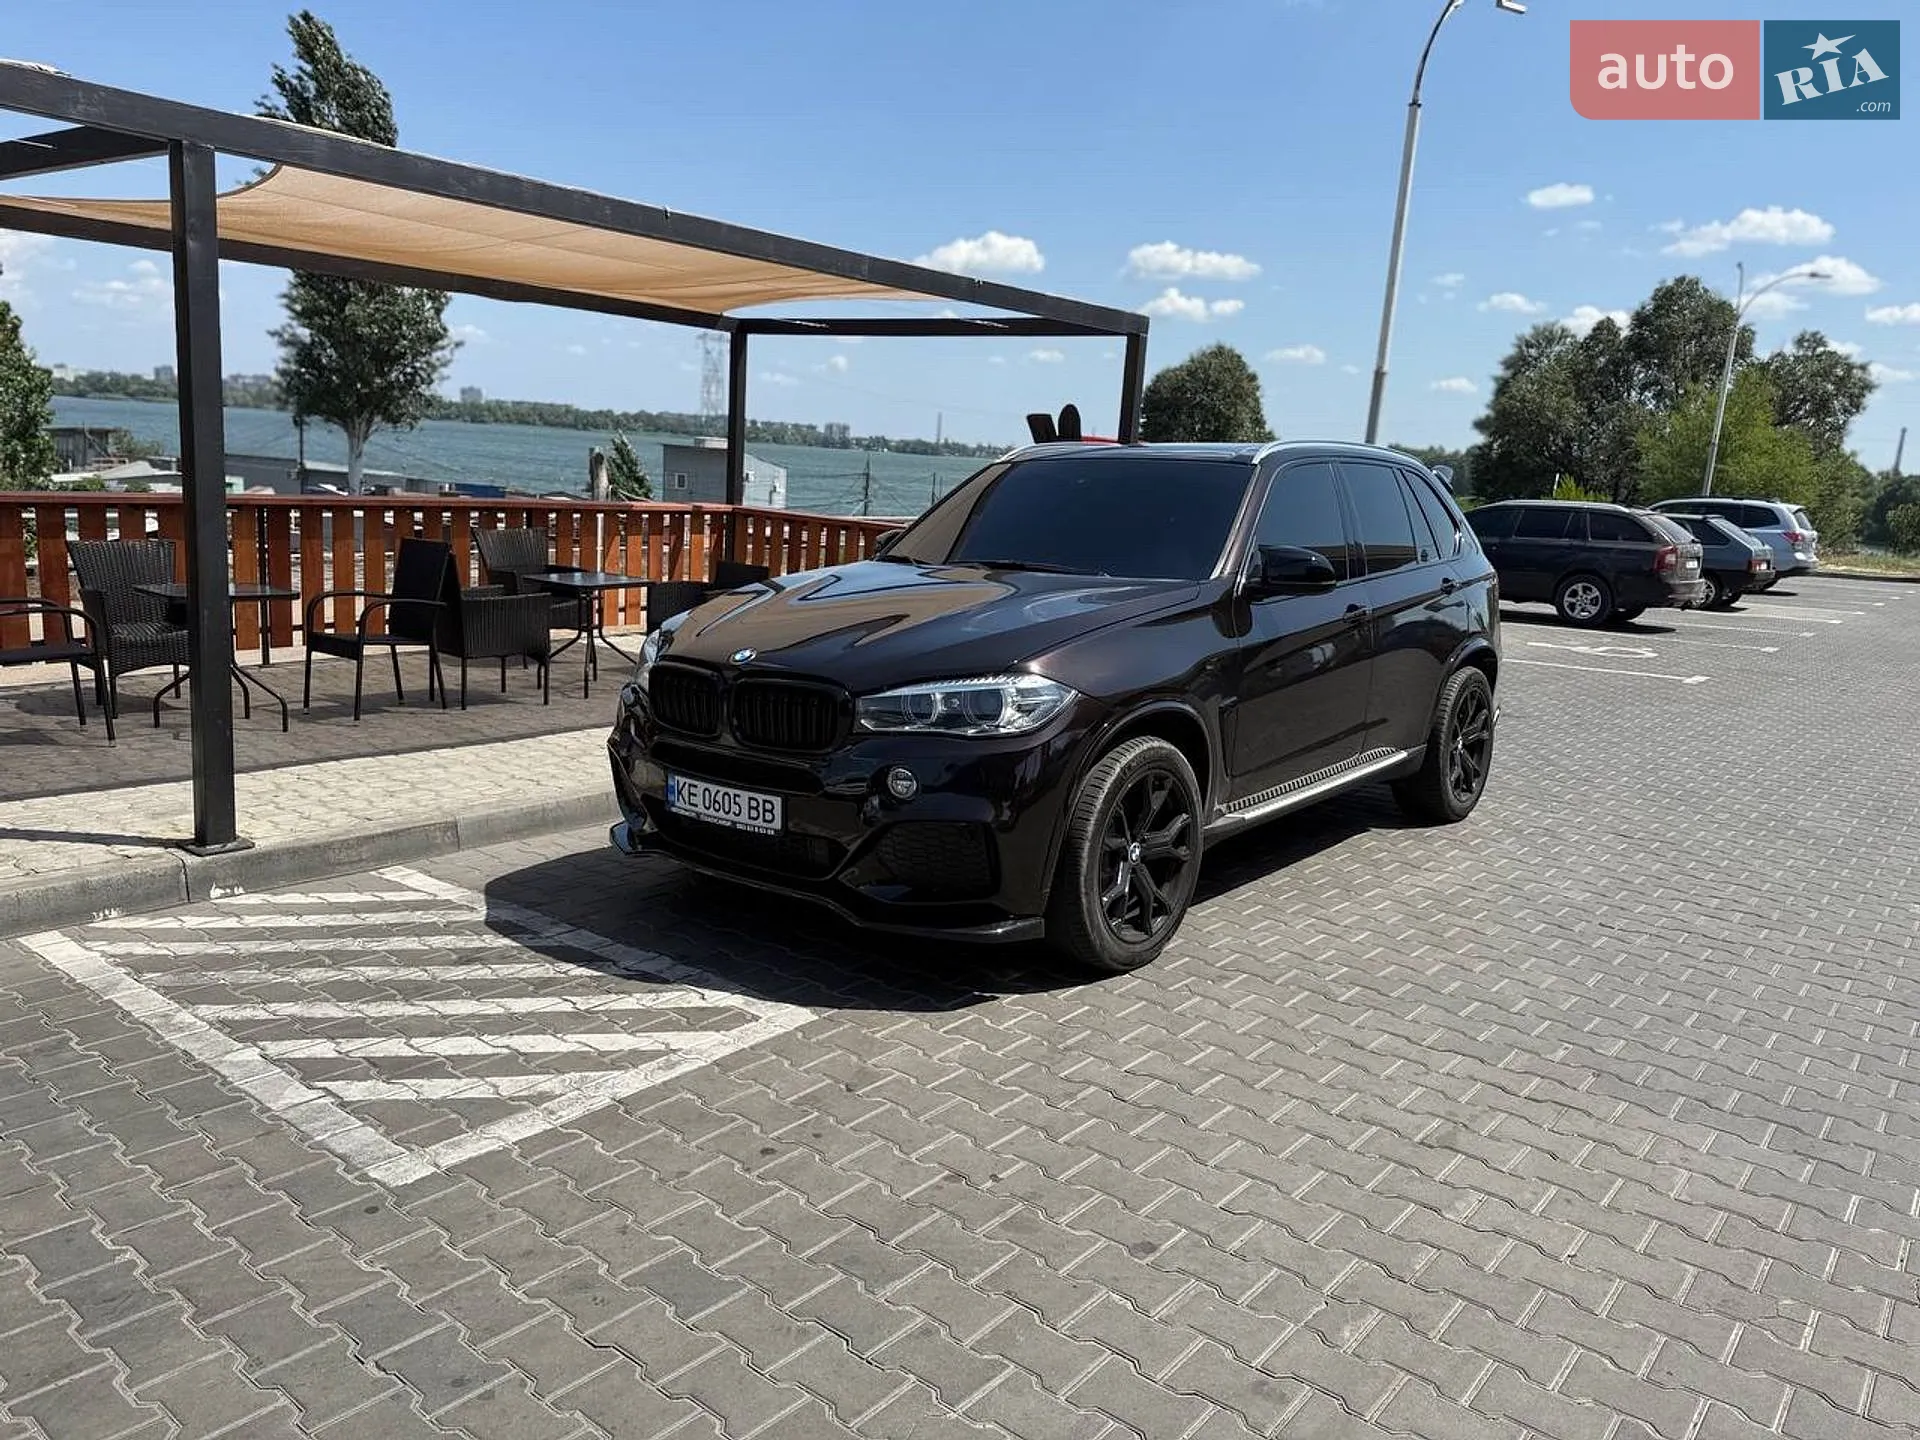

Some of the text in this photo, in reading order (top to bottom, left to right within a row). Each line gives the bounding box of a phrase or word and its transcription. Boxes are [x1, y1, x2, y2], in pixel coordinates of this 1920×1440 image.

[676, 780, 698, 807] KE
[702, 787, 742, 817] 0605
[748, 796, 775, 824] BB
